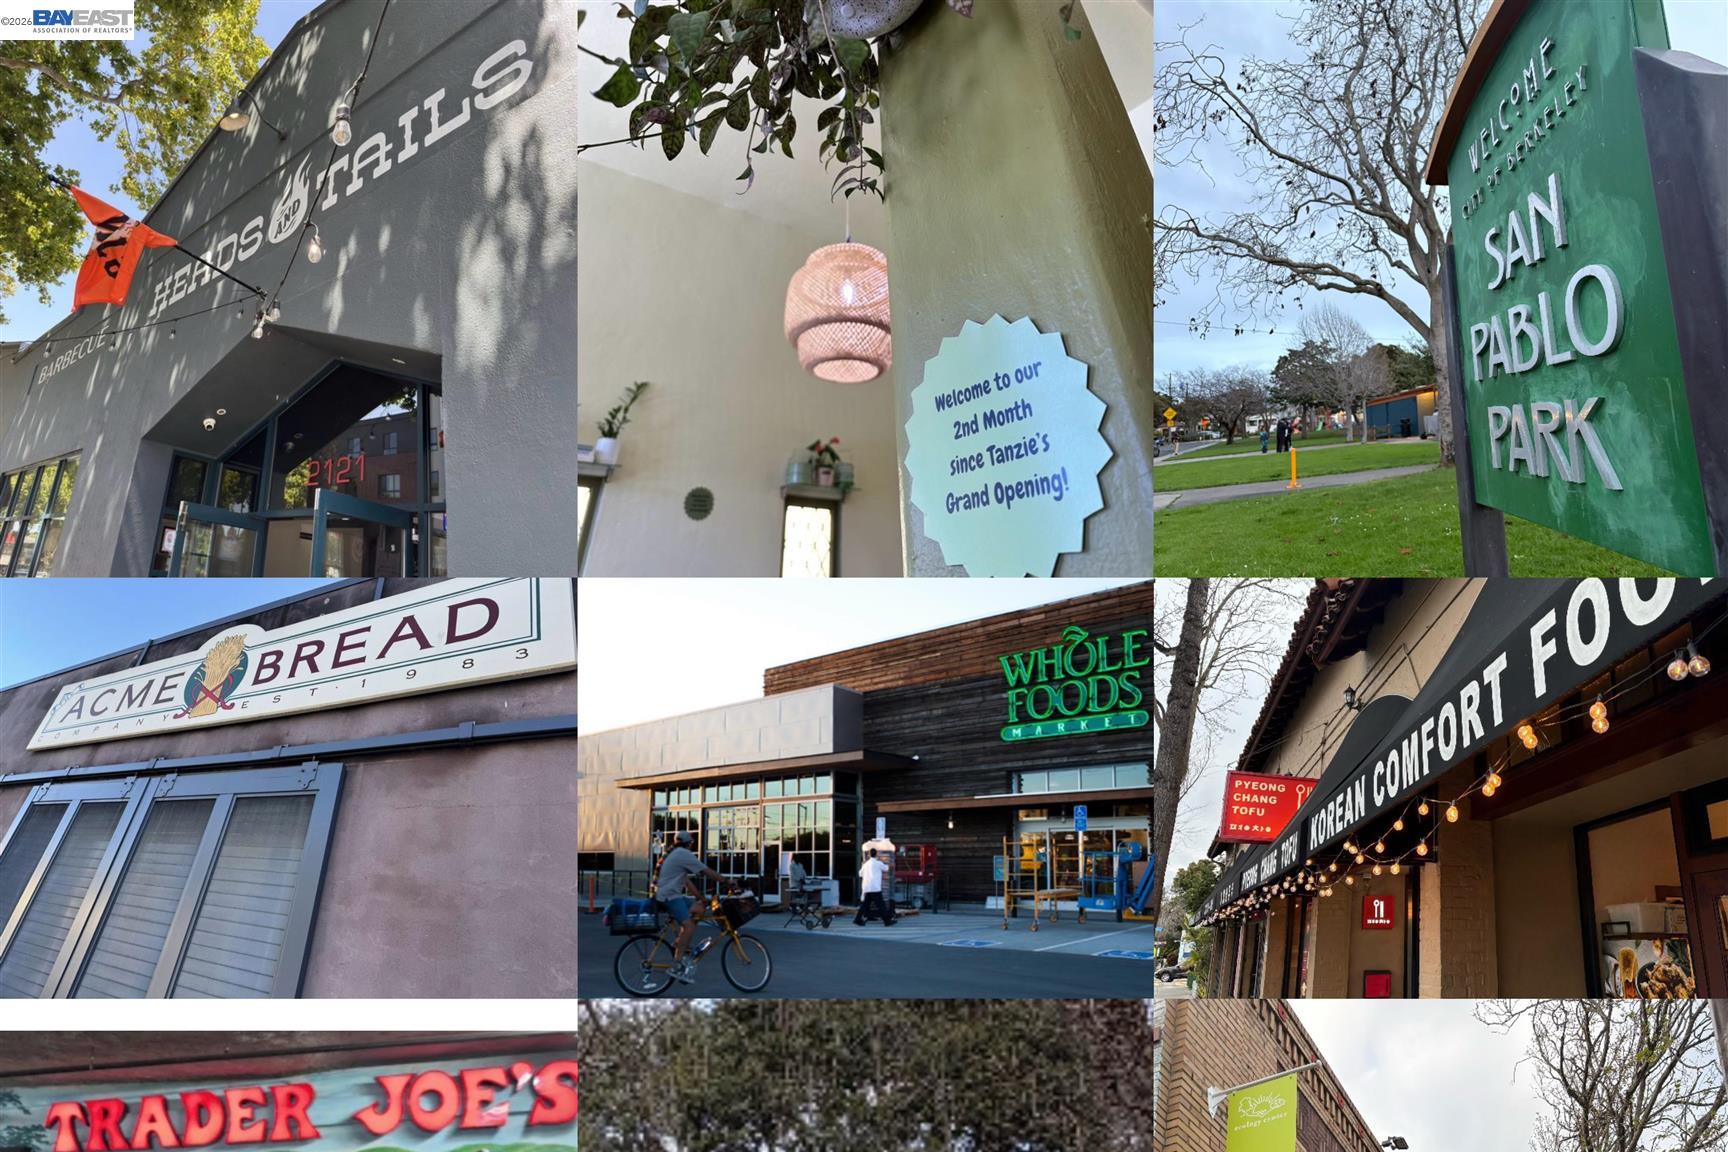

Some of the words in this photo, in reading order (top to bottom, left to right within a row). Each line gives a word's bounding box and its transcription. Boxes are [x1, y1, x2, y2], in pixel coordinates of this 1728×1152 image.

[149, 216, 264, 318] HEADS
[274, 198, 301, 239] AND
[317, 39, 533, 212] TAILS
[1484, 173, 1568, 290] SAN
[1470, 263, 1624, 381] PABLO
[38, 328, 109, 385] BARBECUE
[934, 379, 992, 412] Welcome
[993, 372, 1011, 391] to
[1014, 361, 1042, 384] our
[953, 413, 979, 440] 2nd
[983, 398, 1033, 431] Month
[1487, 396, 1624, 491] PARK
[306, 454, 366, 487] 2121
[949, 453, 985, 476] since
[986, 432, 1050, 467] Tanzie's
[946, 483, 990, 514] Grand
[994, 466, 1070, 510] Opening!
[59, 671, 187, 724] ACME
[252, 597, 500, 687] BREAD
[998, 626, 1150, 687] WHOLE
[1007, 670, 1142, 723] FOODS
[37, 713, 170, 742] COMPANY
[1012, 713, 1137, 737] MARKET
[1310, 775, 1366, 851] KOREAN
[1372, 652, 1508, 807] COMFORT
[1232, 805, 1265, 816] TOFU
[1233, 792, 1278, 805] CHANG
[1234, 779, 1286, 793] PYEONG
[1281, 831, 1298, 870] TOFU
[353, 1057, 578, 1136] JOE'S
